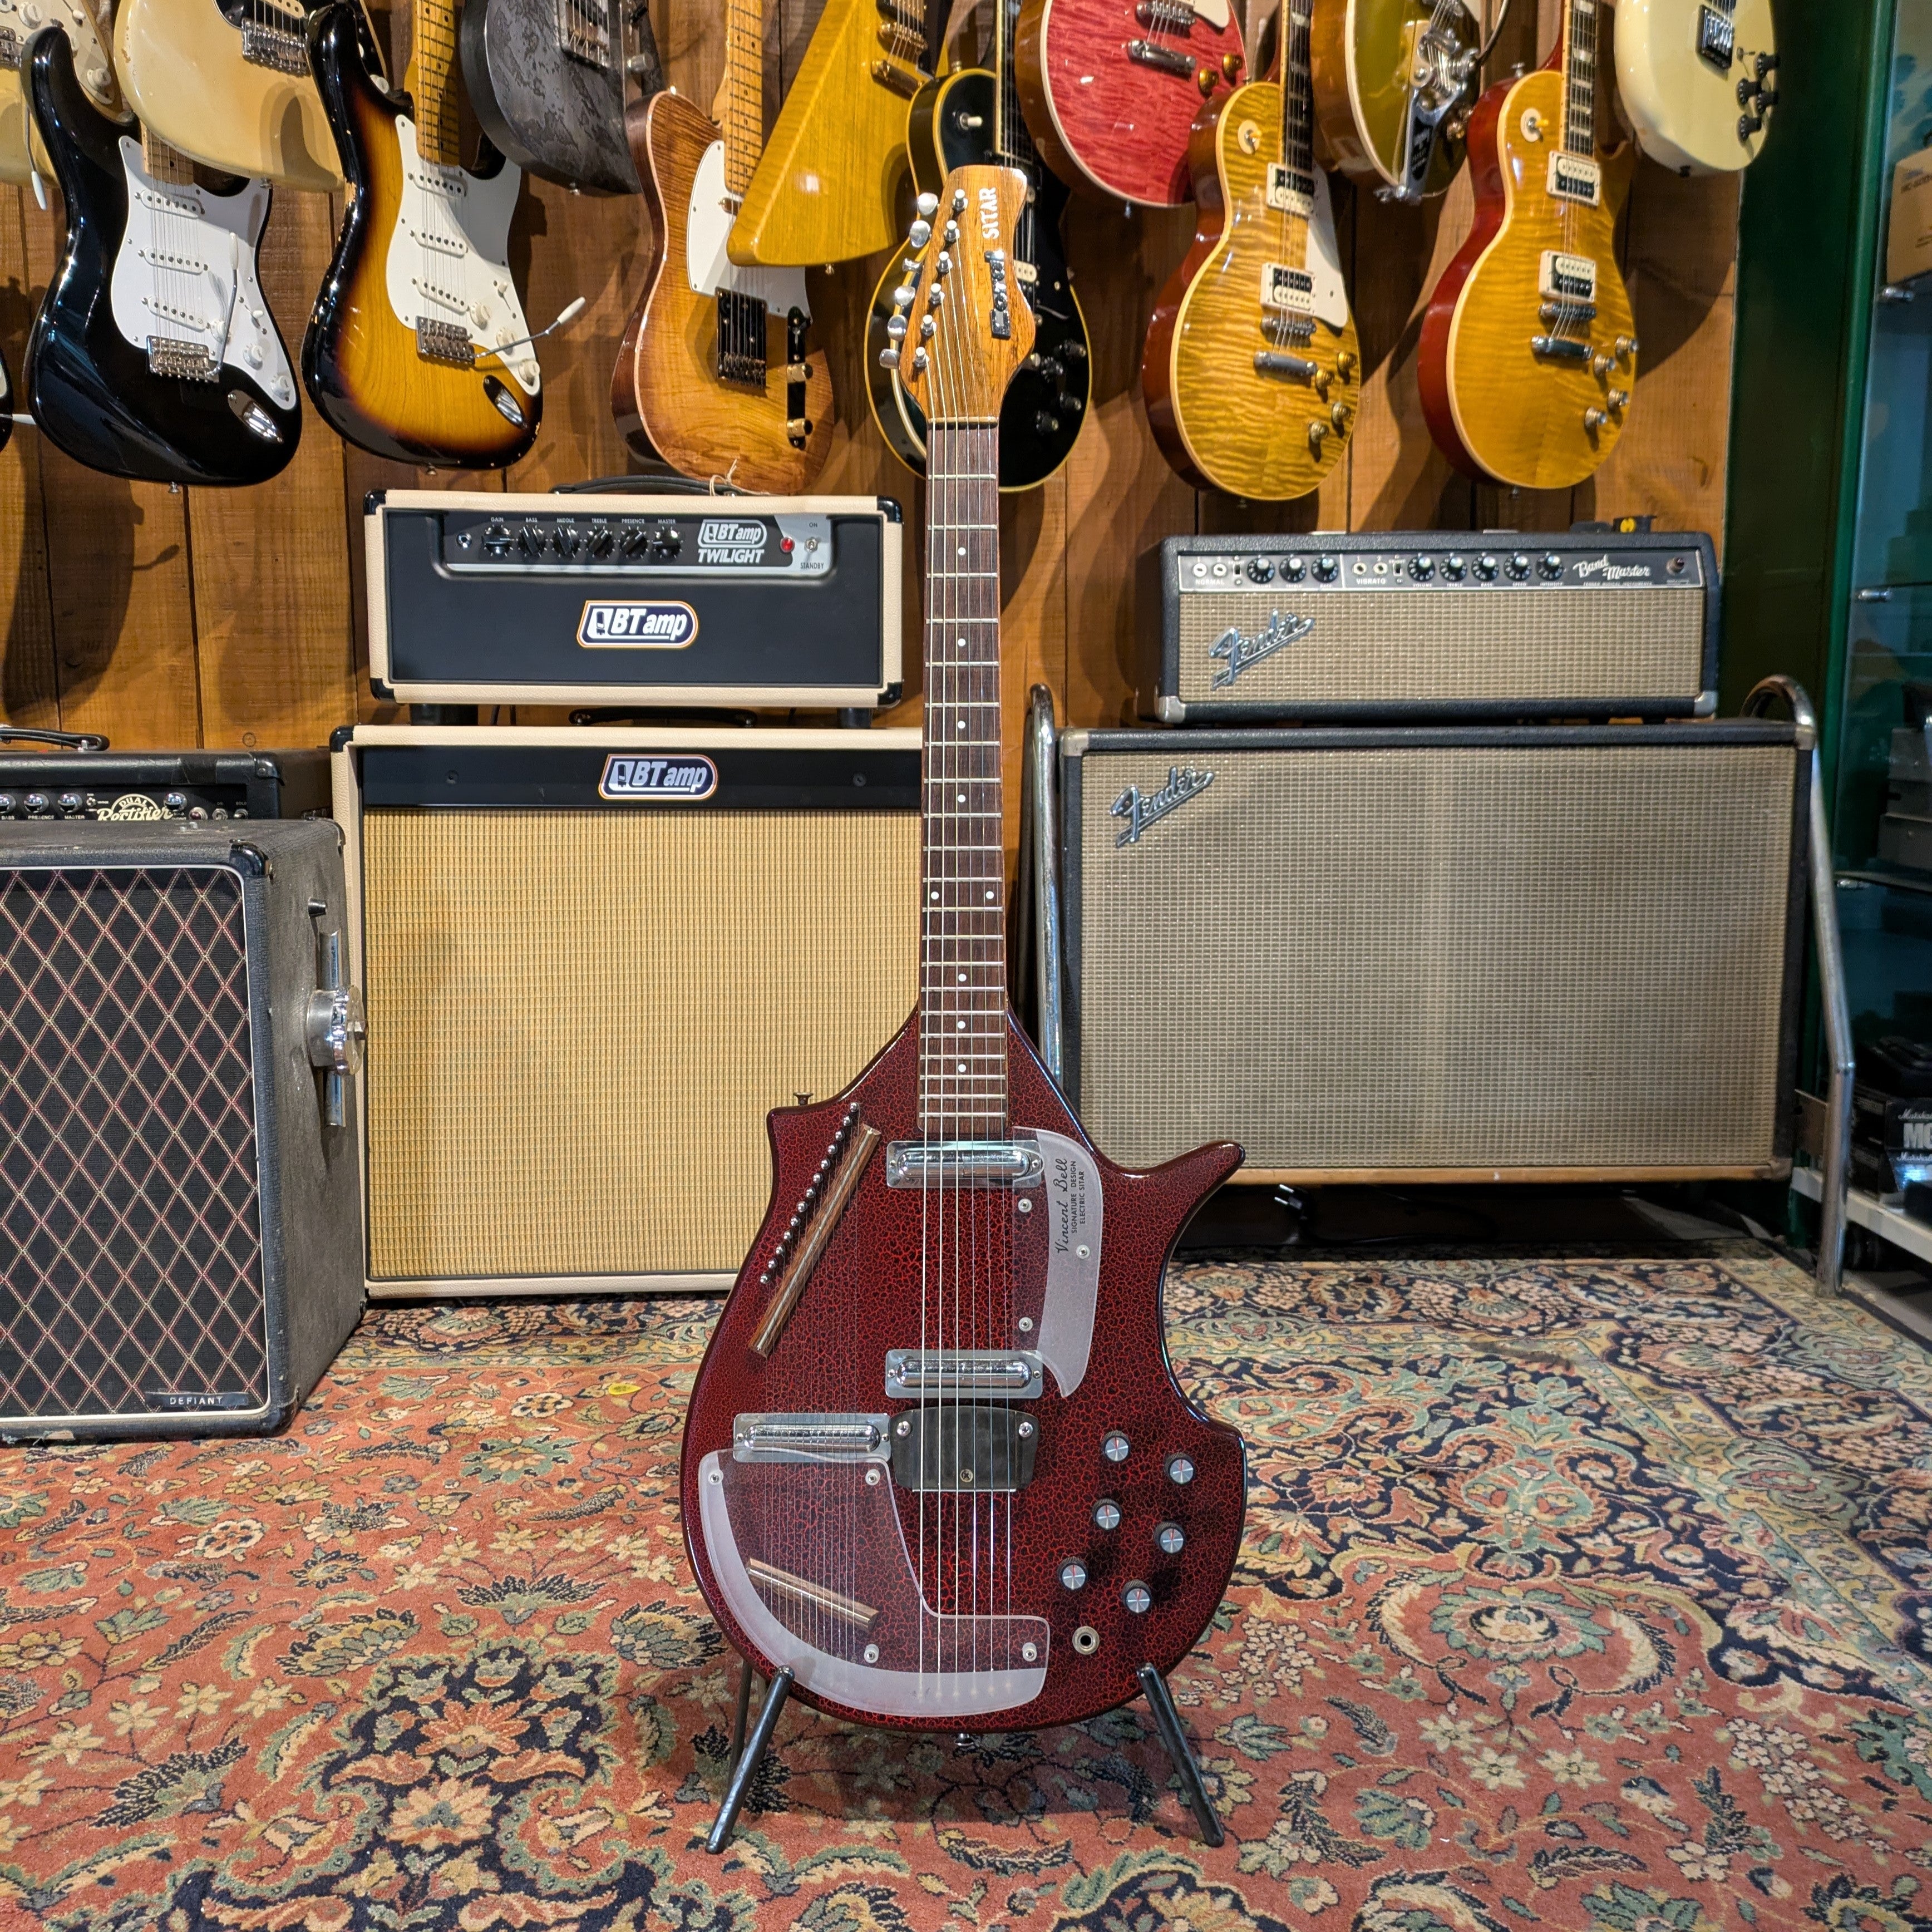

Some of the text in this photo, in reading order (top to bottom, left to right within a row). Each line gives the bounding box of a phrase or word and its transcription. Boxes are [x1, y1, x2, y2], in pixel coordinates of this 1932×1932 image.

[979, 186, 999, 239] SITAR
[698, 549, 765, 563] TWILIGHT
[1573, 554, 1609, 578] Band
[1602, 565, 1652, 580] Master
[1208, 608, 1315, 689] Fender
[119, 797, 147, 807] DUAL
[1110, 766, 1215, 847] Fender
[97, 806, 174, 821] Rectifier
[1053, 1159, 1069, 1254] Vincent Bell
[169, 1396, 224, 1405] DEFIANT
